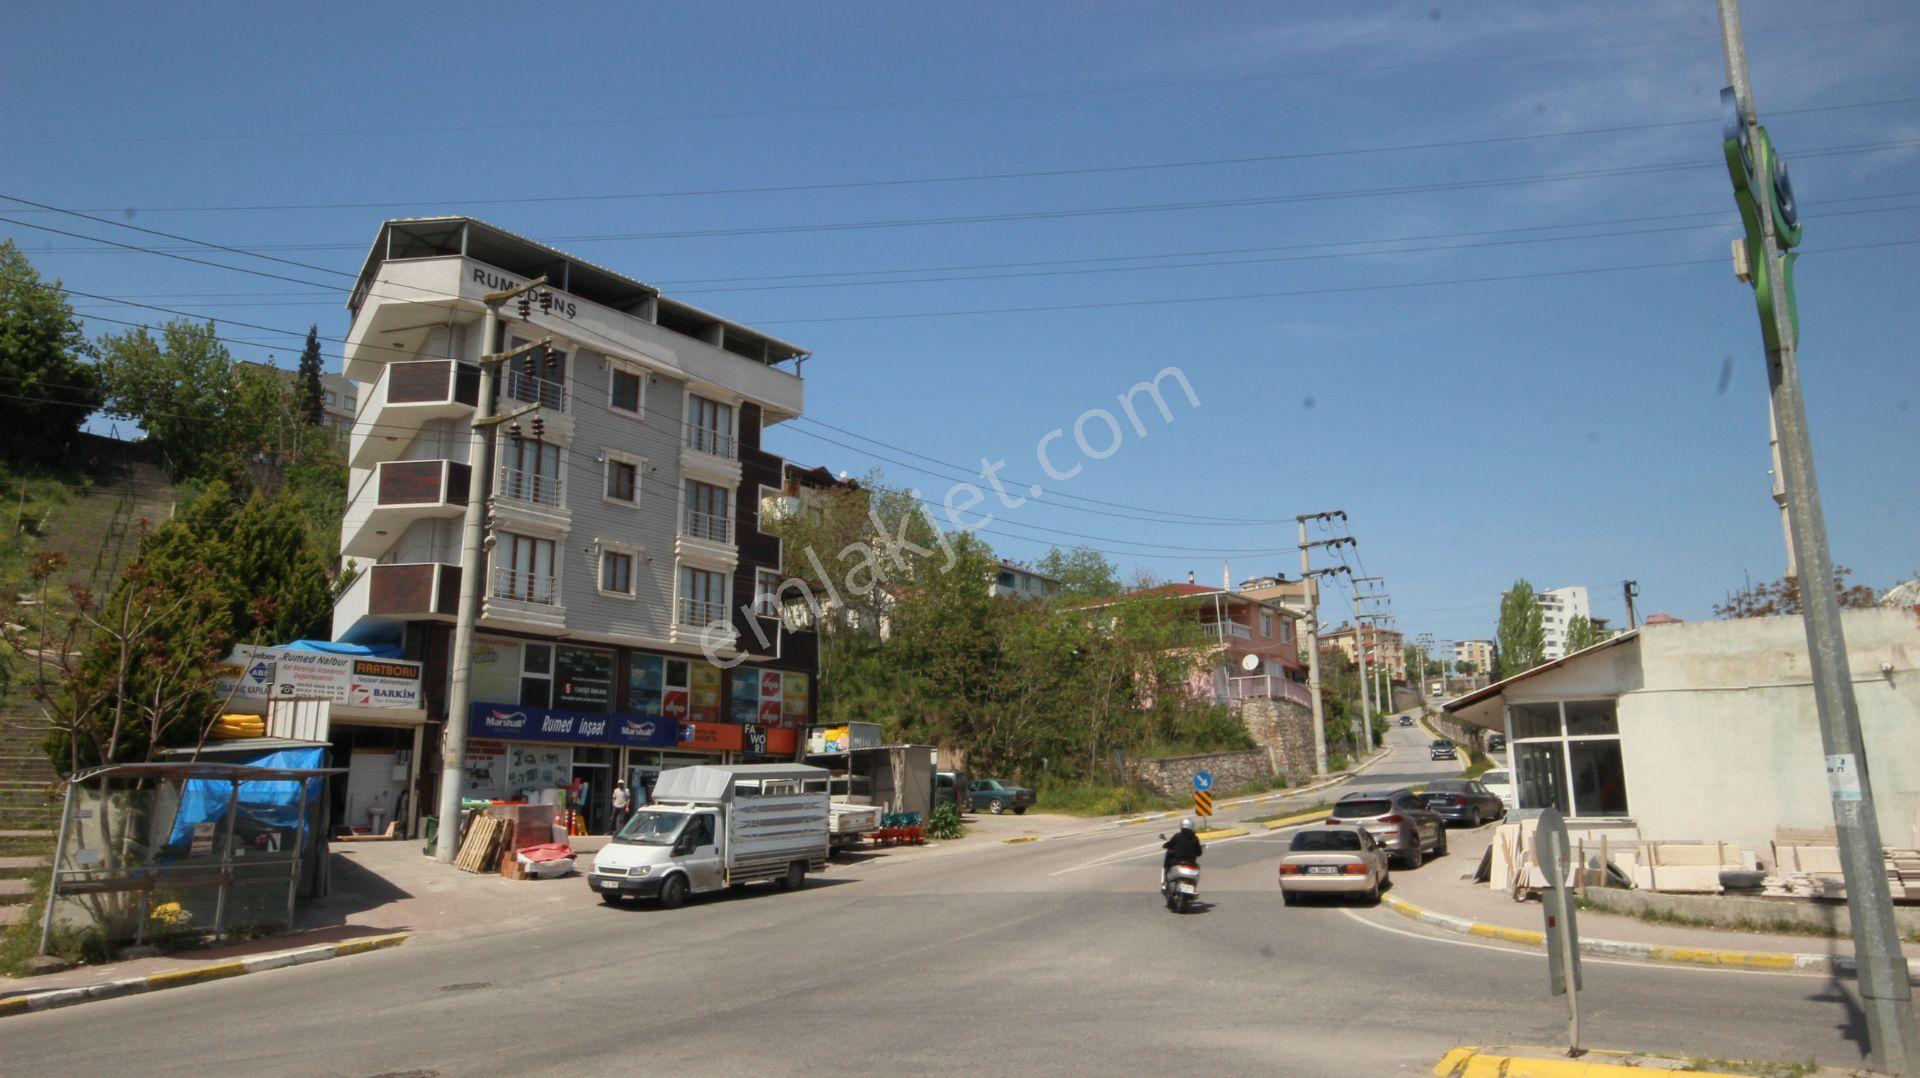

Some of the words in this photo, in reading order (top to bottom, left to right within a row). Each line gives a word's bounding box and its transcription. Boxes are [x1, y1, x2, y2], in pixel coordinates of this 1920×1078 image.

[473, 268, 538, 303] RUMD
[282, 652, 317, 664] Rumed
[317, 656, 348, 667] Nalbur
[373, 688, 416, 699] BARKİM
[485, 716, 524, 728] Marshall
[541, 715, 574, 733] Rumed
[578, 718, 606, 737] inşaat
[621, 726, 653, 737] Marshall
